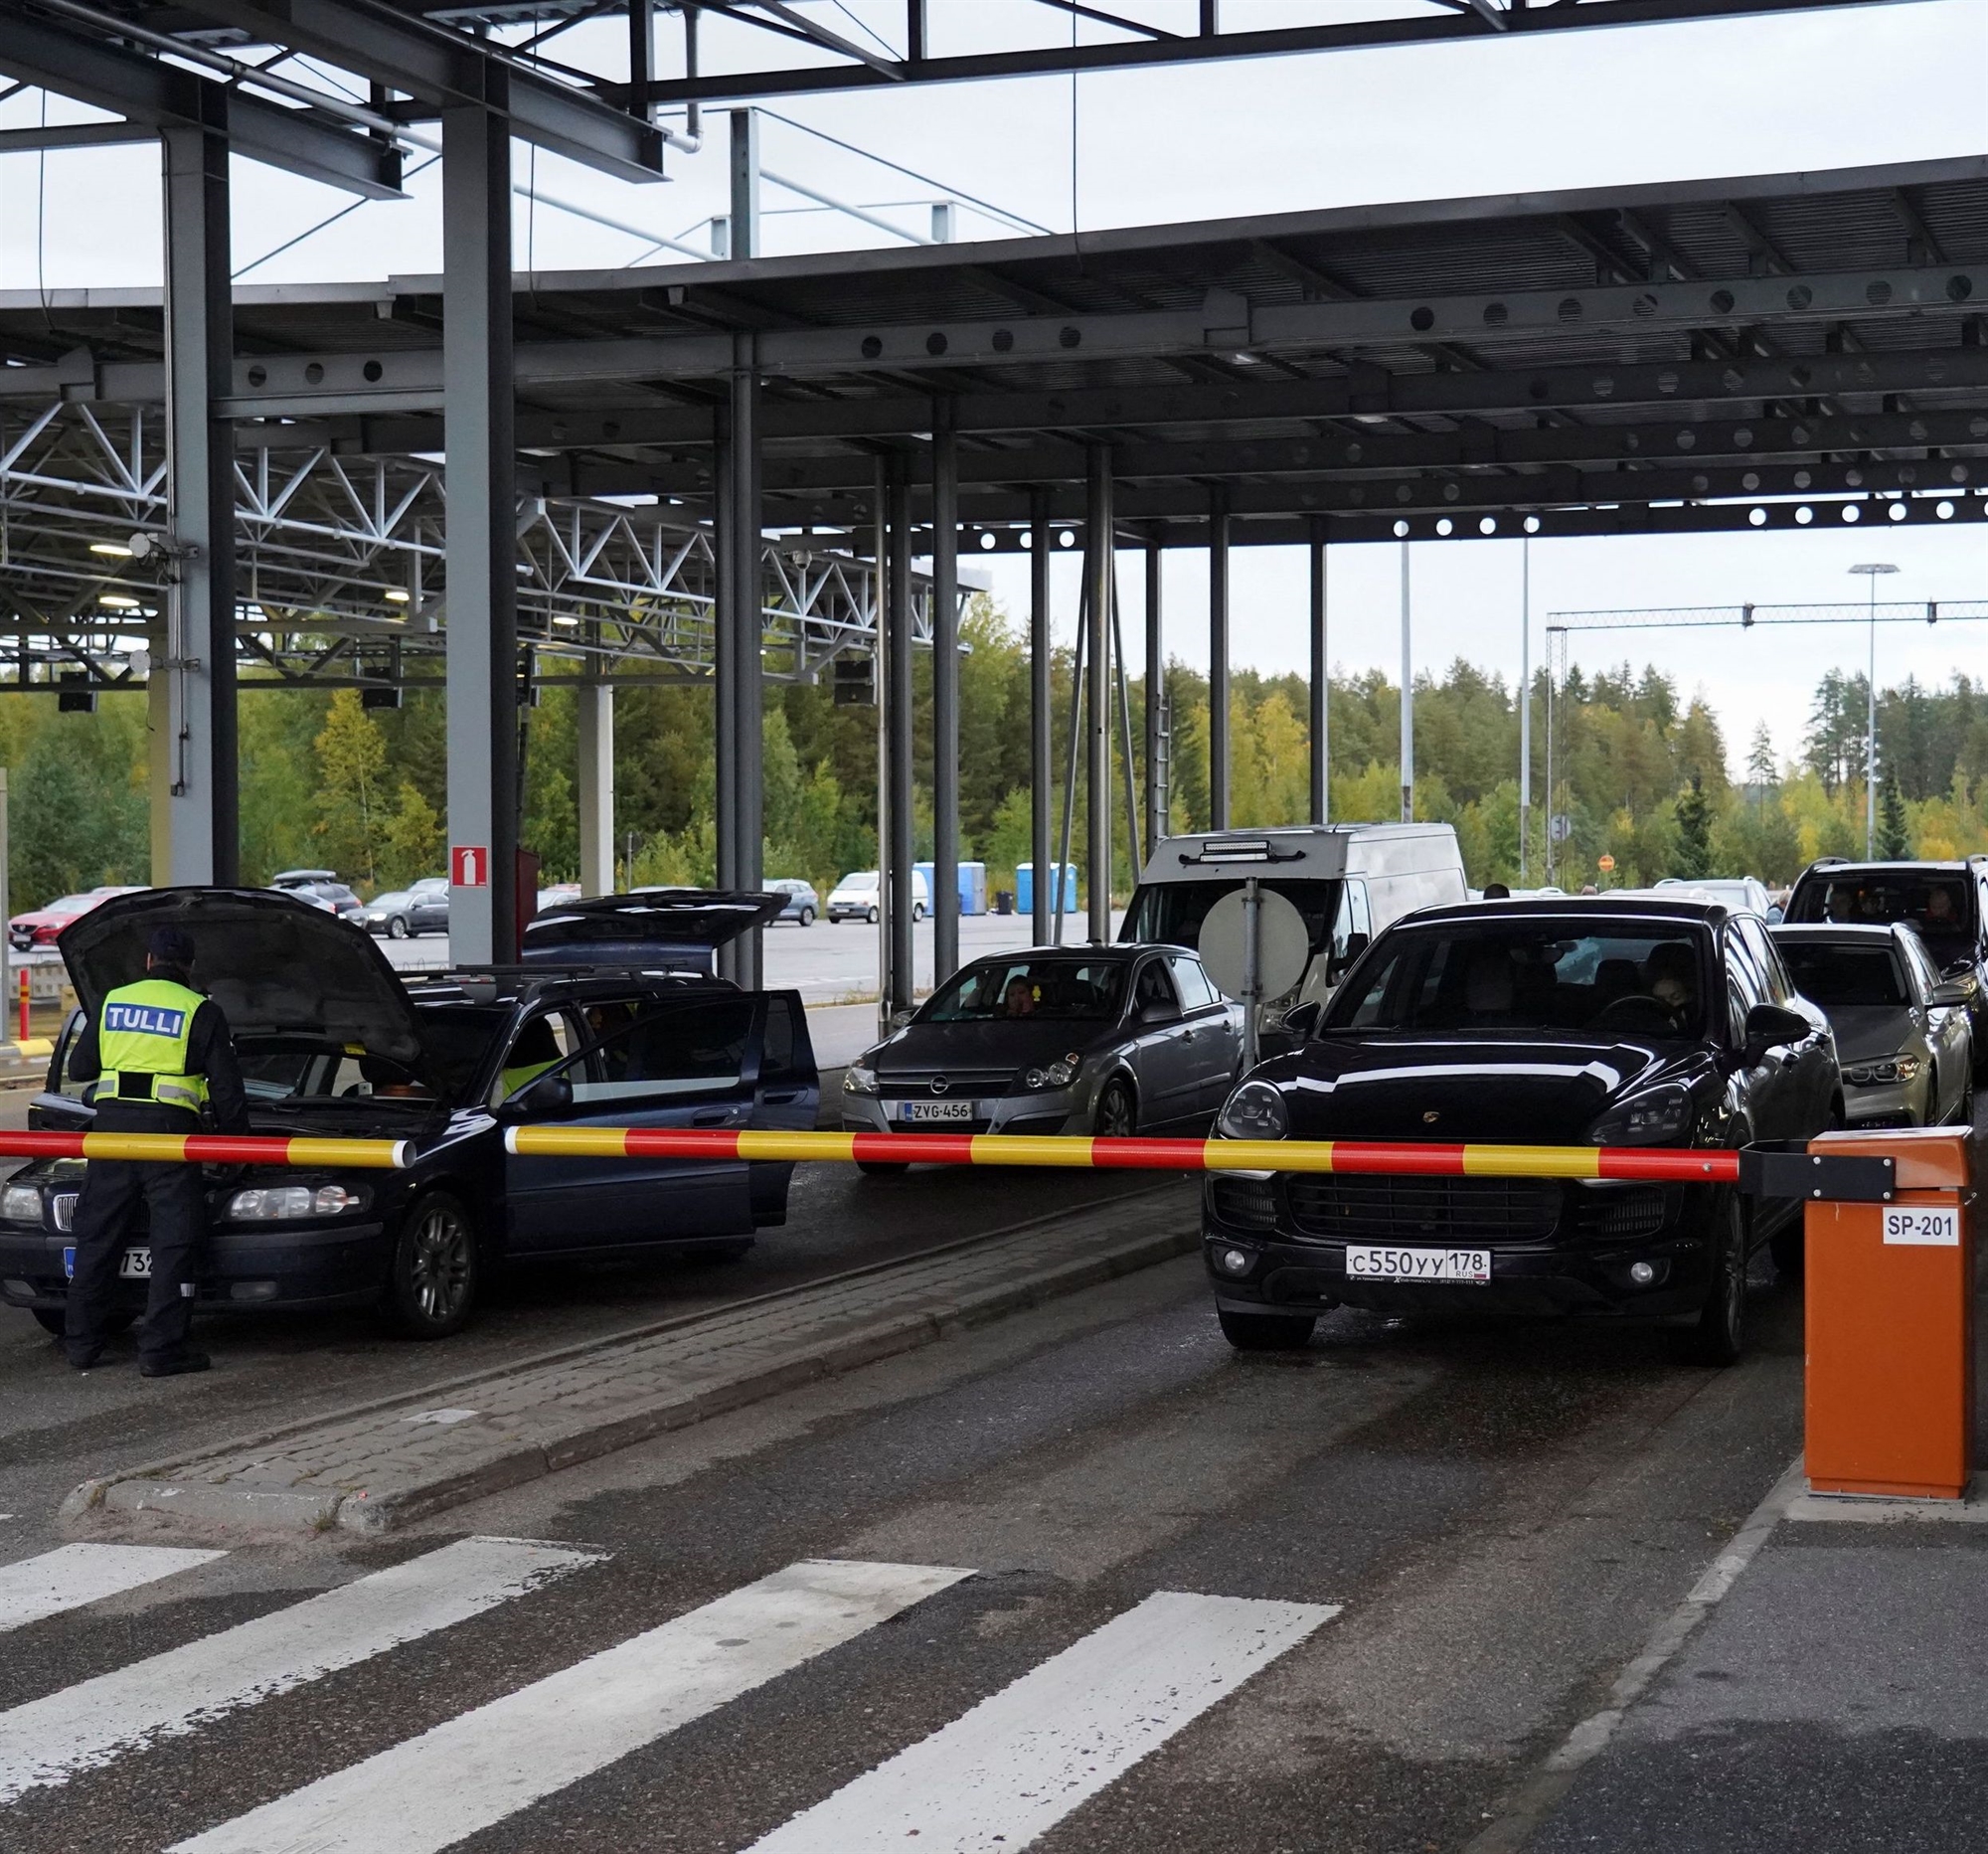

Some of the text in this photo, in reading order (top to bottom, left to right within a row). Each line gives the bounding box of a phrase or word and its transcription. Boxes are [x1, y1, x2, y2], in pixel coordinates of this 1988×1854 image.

[109, 1007, 181, 1034] TULLI
[1888, 1215, 1951, 1236] SP-201
[1448, 1253, 1483, 1270] 178
